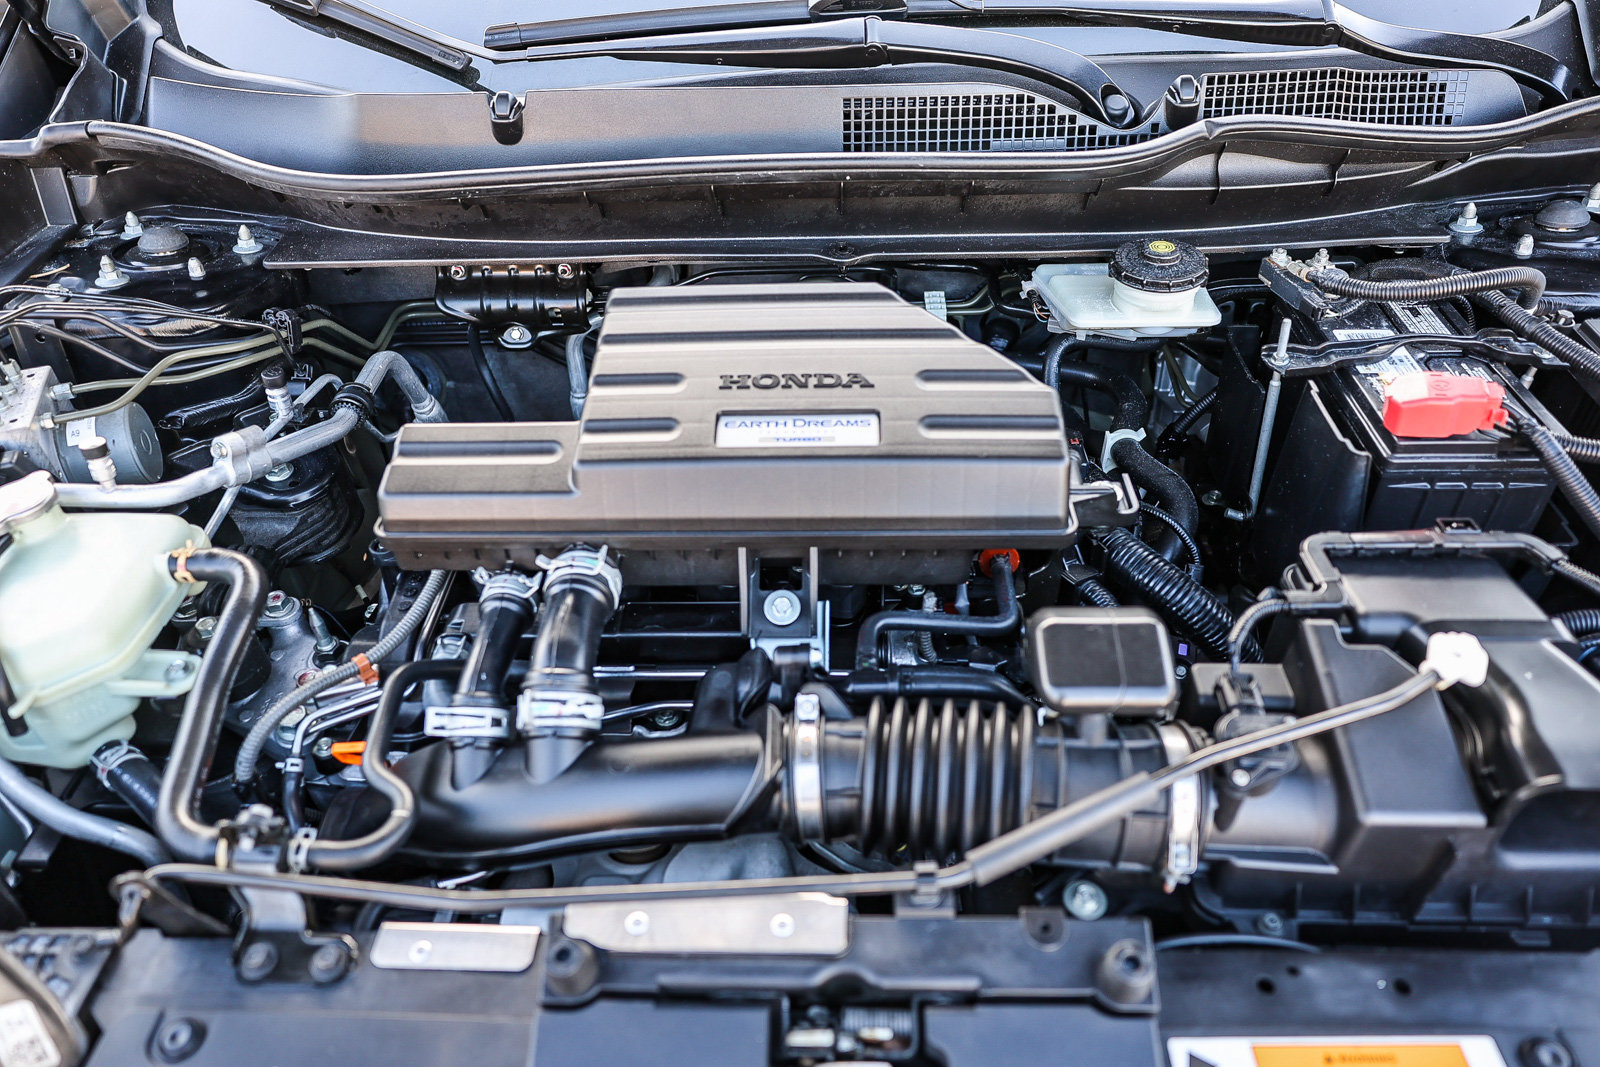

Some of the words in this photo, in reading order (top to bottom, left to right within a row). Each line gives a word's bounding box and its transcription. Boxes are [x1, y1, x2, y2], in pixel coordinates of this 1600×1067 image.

[718, 373, 875, 390] HONDA
[724, 420, 787, 429] EARTH
[792, 418, 872, 428] DREAMS
